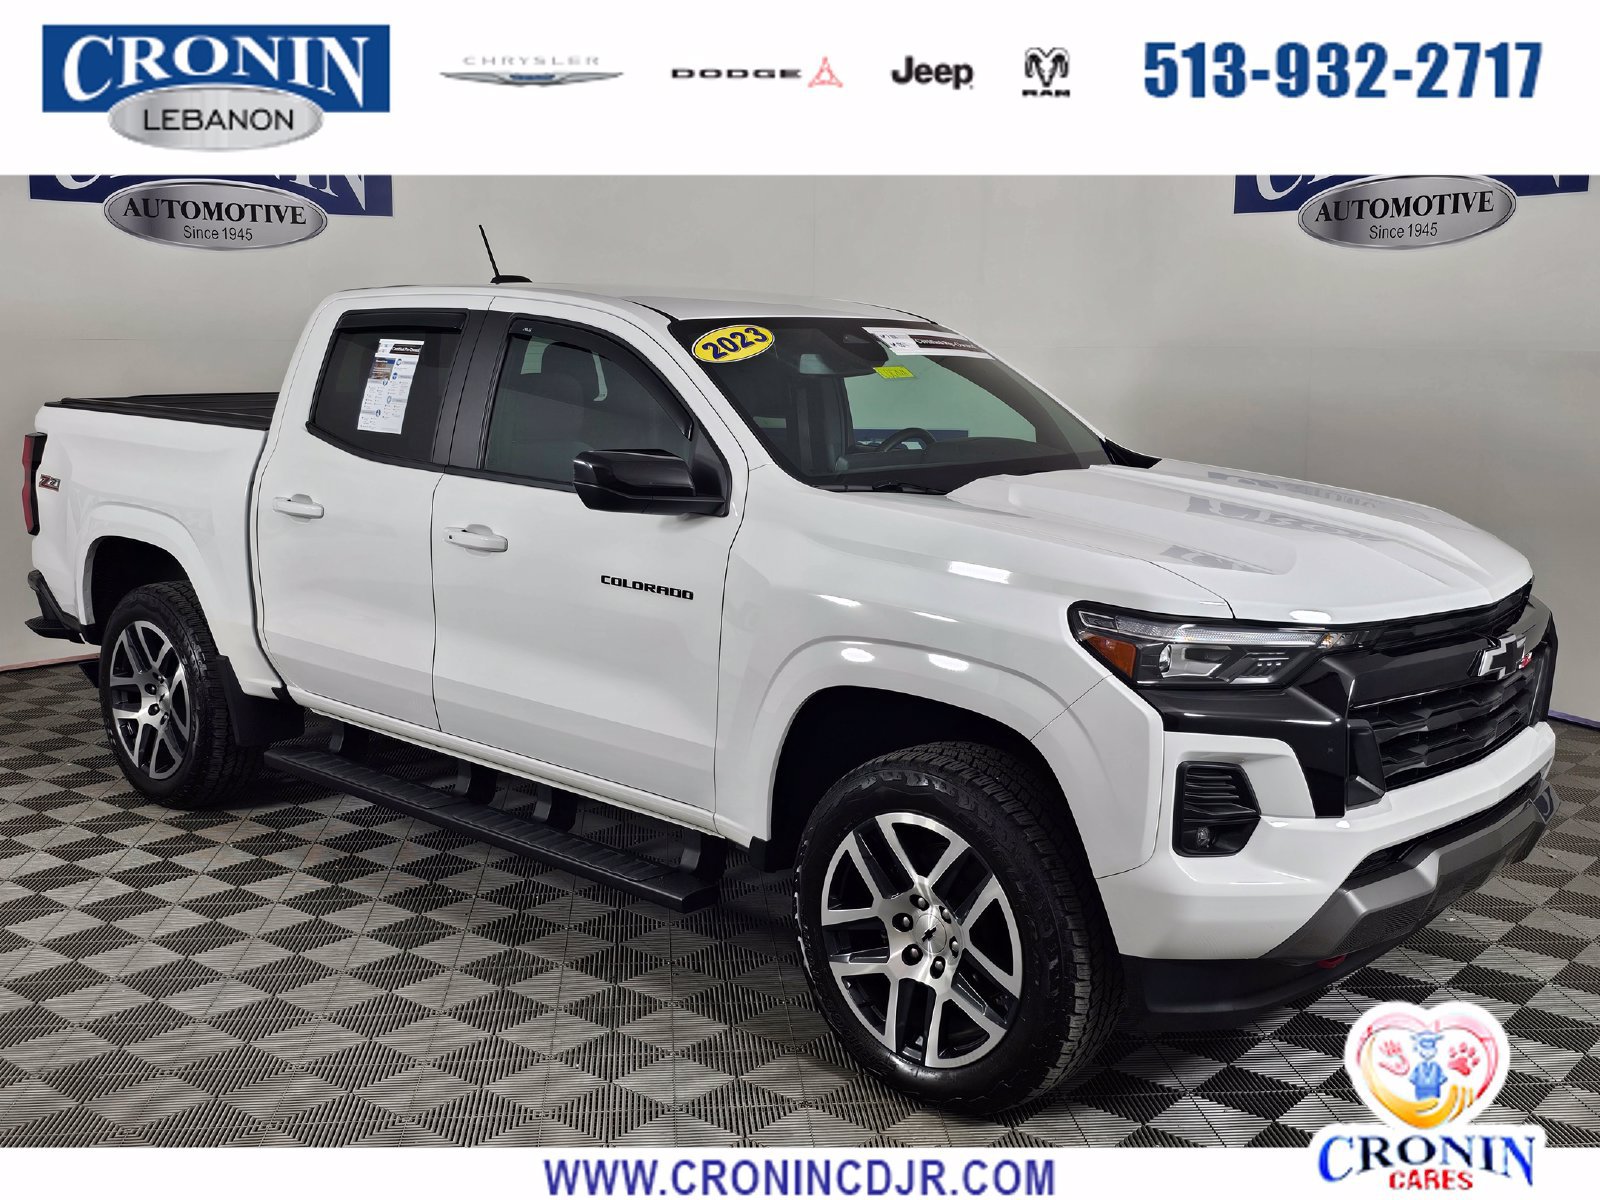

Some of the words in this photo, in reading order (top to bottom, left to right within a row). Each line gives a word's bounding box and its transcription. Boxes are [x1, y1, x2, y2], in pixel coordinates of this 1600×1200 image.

[122, 198, 307, 225] AUTOMOTIVE
[1314, 191, 1494, 222] AUTOMOTIVE
[183, 225, 219, 240] Since
[222, 227, 253, 241] 1945
[1369, 224, 1405, 239] Since
[1408, 222, 1438, 237] 1945
[702, 327, 768, 359] 2023
[601, 575, 694, 600] COLORADO
